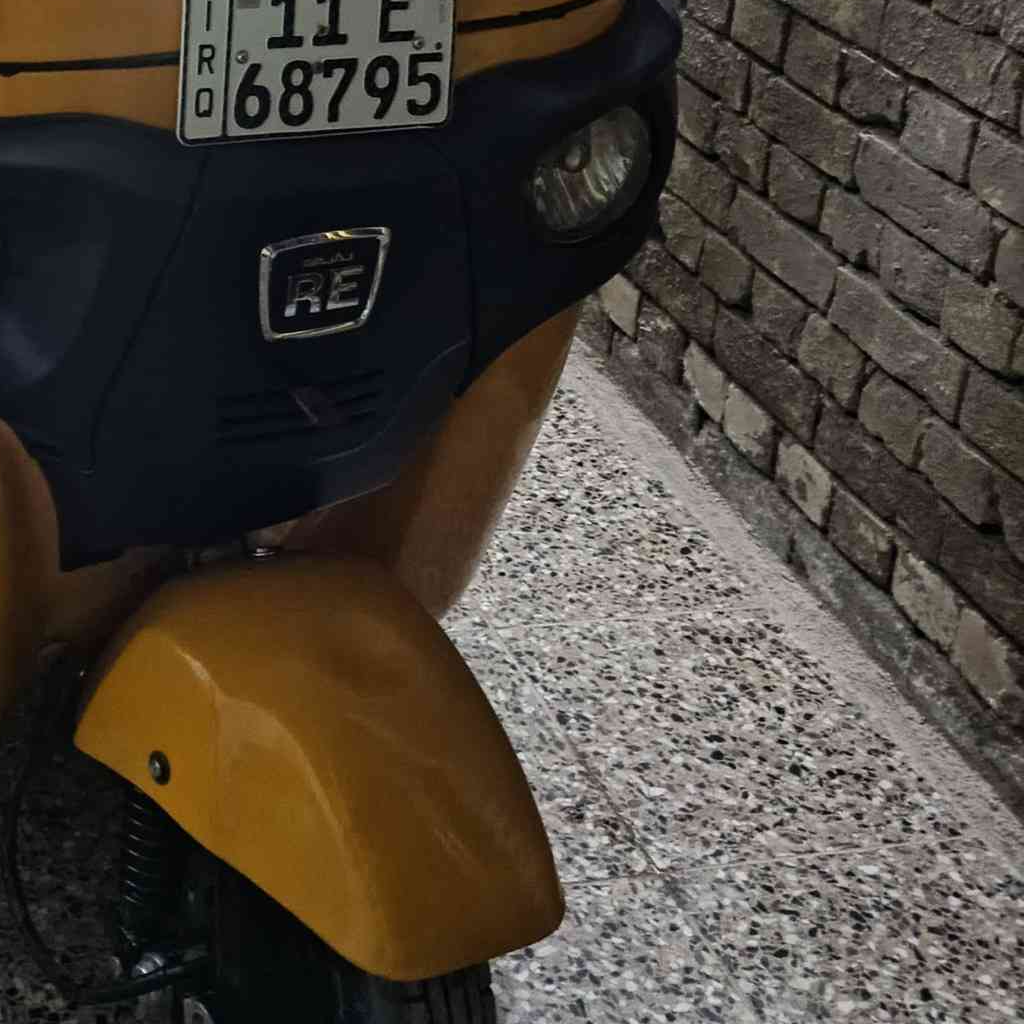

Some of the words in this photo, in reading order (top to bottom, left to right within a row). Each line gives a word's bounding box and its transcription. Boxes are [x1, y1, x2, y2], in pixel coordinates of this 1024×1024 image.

[194, 0, 216, 118] IRQ
[234, 52, 444, 129] 68795
[284, 265, 365, 318] RE
